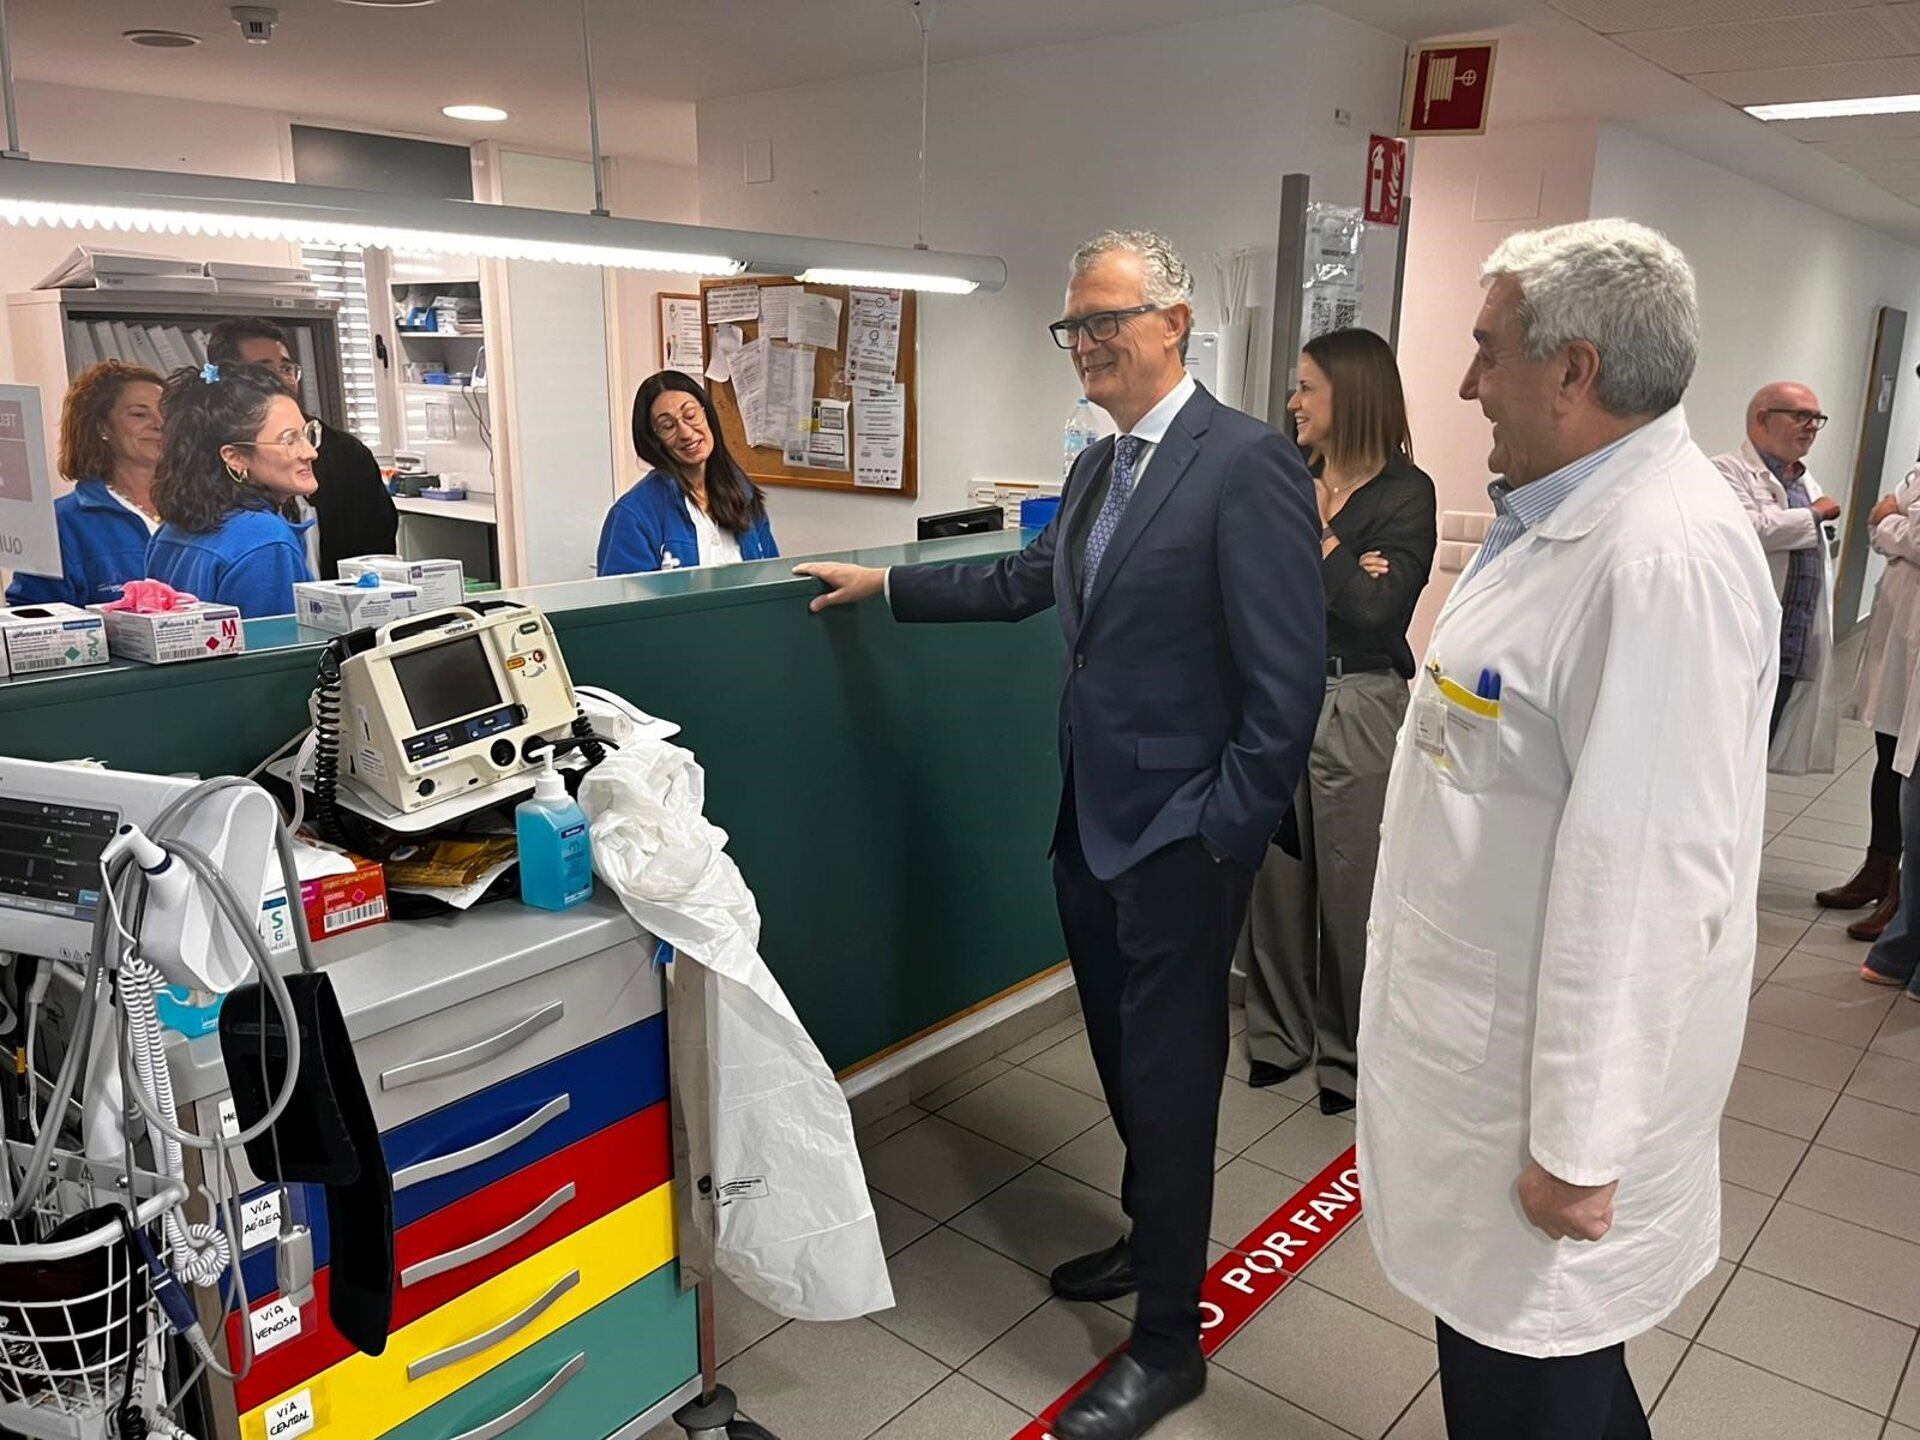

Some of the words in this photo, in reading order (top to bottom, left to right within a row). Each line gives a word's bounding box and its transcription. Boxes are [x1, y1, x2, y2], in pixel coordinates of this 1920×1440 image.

[221, 620, 237, 637] M
[86, 630, 99, 647] S
[226, 637, 236, 649] 7
[88, 647, 98, 658] 6
[270, 911, 284, 930] S
[274, 930, 284, 941] 6
[1221, 1231, 1309, 1294] POR
[1289, 1166, 1360, 1233] FAVO
[255, 1315, 298, 1340] VENOSA
[269, 1410, 310, 1436] CENTRAL
